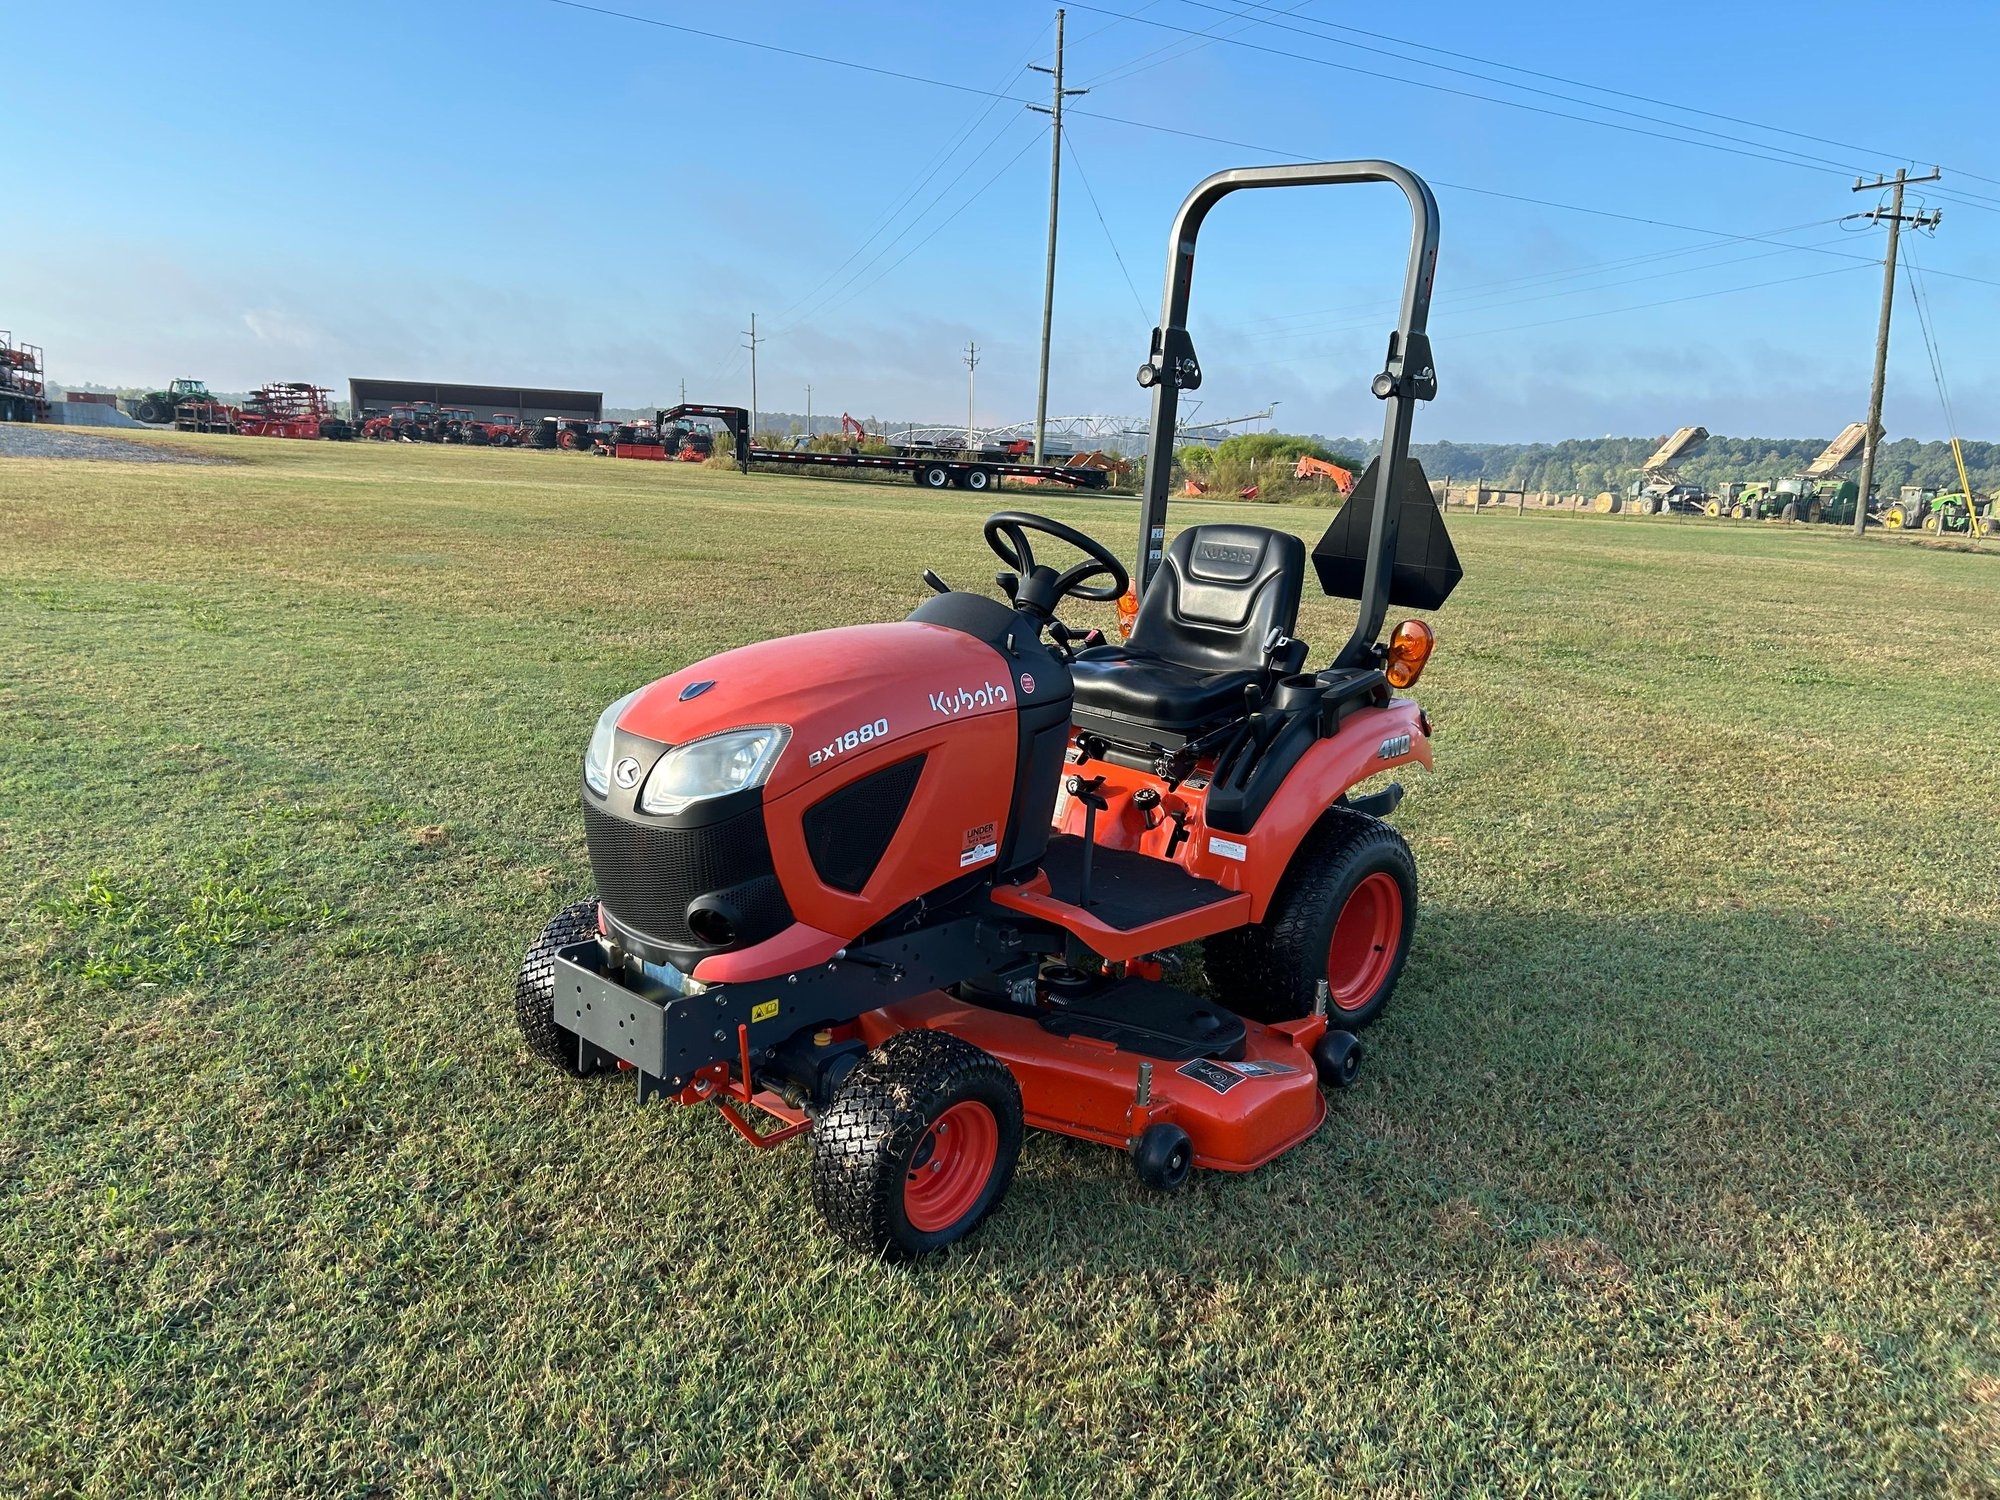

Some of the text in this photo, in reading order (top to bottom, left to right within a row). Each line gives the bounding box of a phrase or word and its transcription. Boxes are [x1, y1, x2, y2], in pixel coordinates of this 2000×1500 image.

[1201, 544, 1252, 564] Kubota
[929, 681, 1008, 715] Kubota
[808, 718, 889, 768] BX1880
[1378, 734, 1411, 760] 4WD
[967, 823, 993, 837] LINDER
